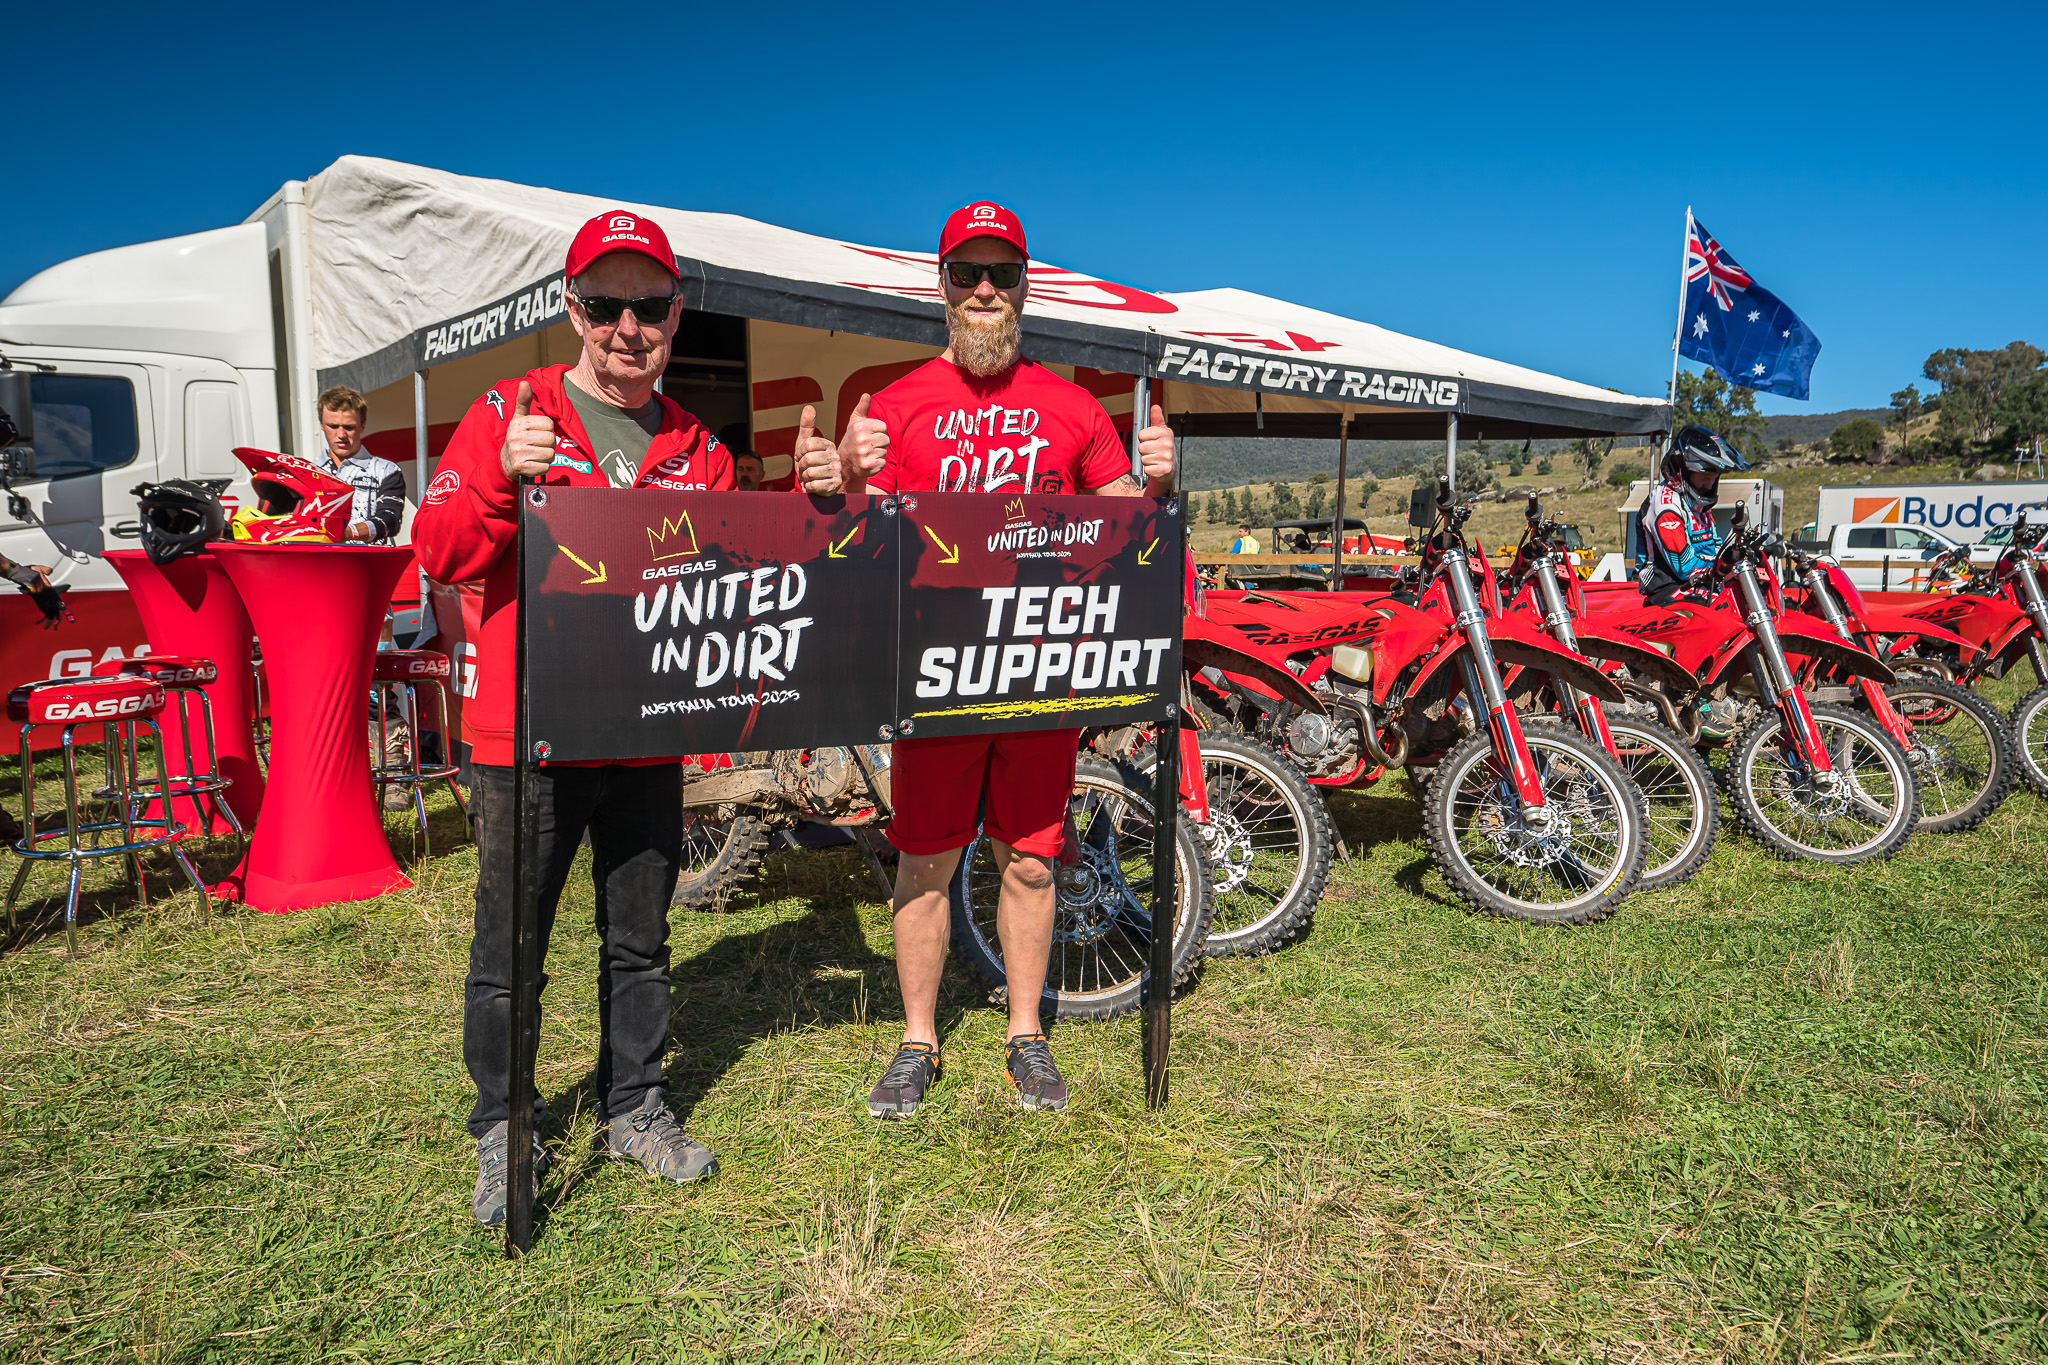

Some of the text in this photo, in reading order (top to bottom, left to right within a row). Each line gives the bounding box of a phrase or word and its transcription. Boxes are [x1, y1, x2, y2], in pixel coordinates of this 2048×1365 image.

[602, 233, 650, 245] GASGAS
[966, 220, 1008, 231] GASGAS
[424, 275, 568, 361] FACTORY RACI
[1157, 343, 1460, 406] FACTORY RACING
[934, 403, 1040, 440] UNITED
[957, 438, 975, 457] IN
[938, 434, 1051, 494] DIRT
[640, 473, 708, 491] GASGAS
[987, 519, 1104, 552] UNITED IN DIRT
[1005, 520, 1032, 530] GASGAS
[642, 559, 717, 580] GASGAS
[634, 563, 807, 632] UNITED
[982, 585, 1121, 637] TECH
[1243, 616, 1384, 645] GASGAS
[651, 617, 814, 688] IN DIRT
[915, 638, 1172, 698] SUPPORT
[45, 692, 165, 720] GASGAS
[641, 689, 800, 718] AUSTRALIA TOUR 2025
[1603, 870, 1625, 896] MAXXIS
